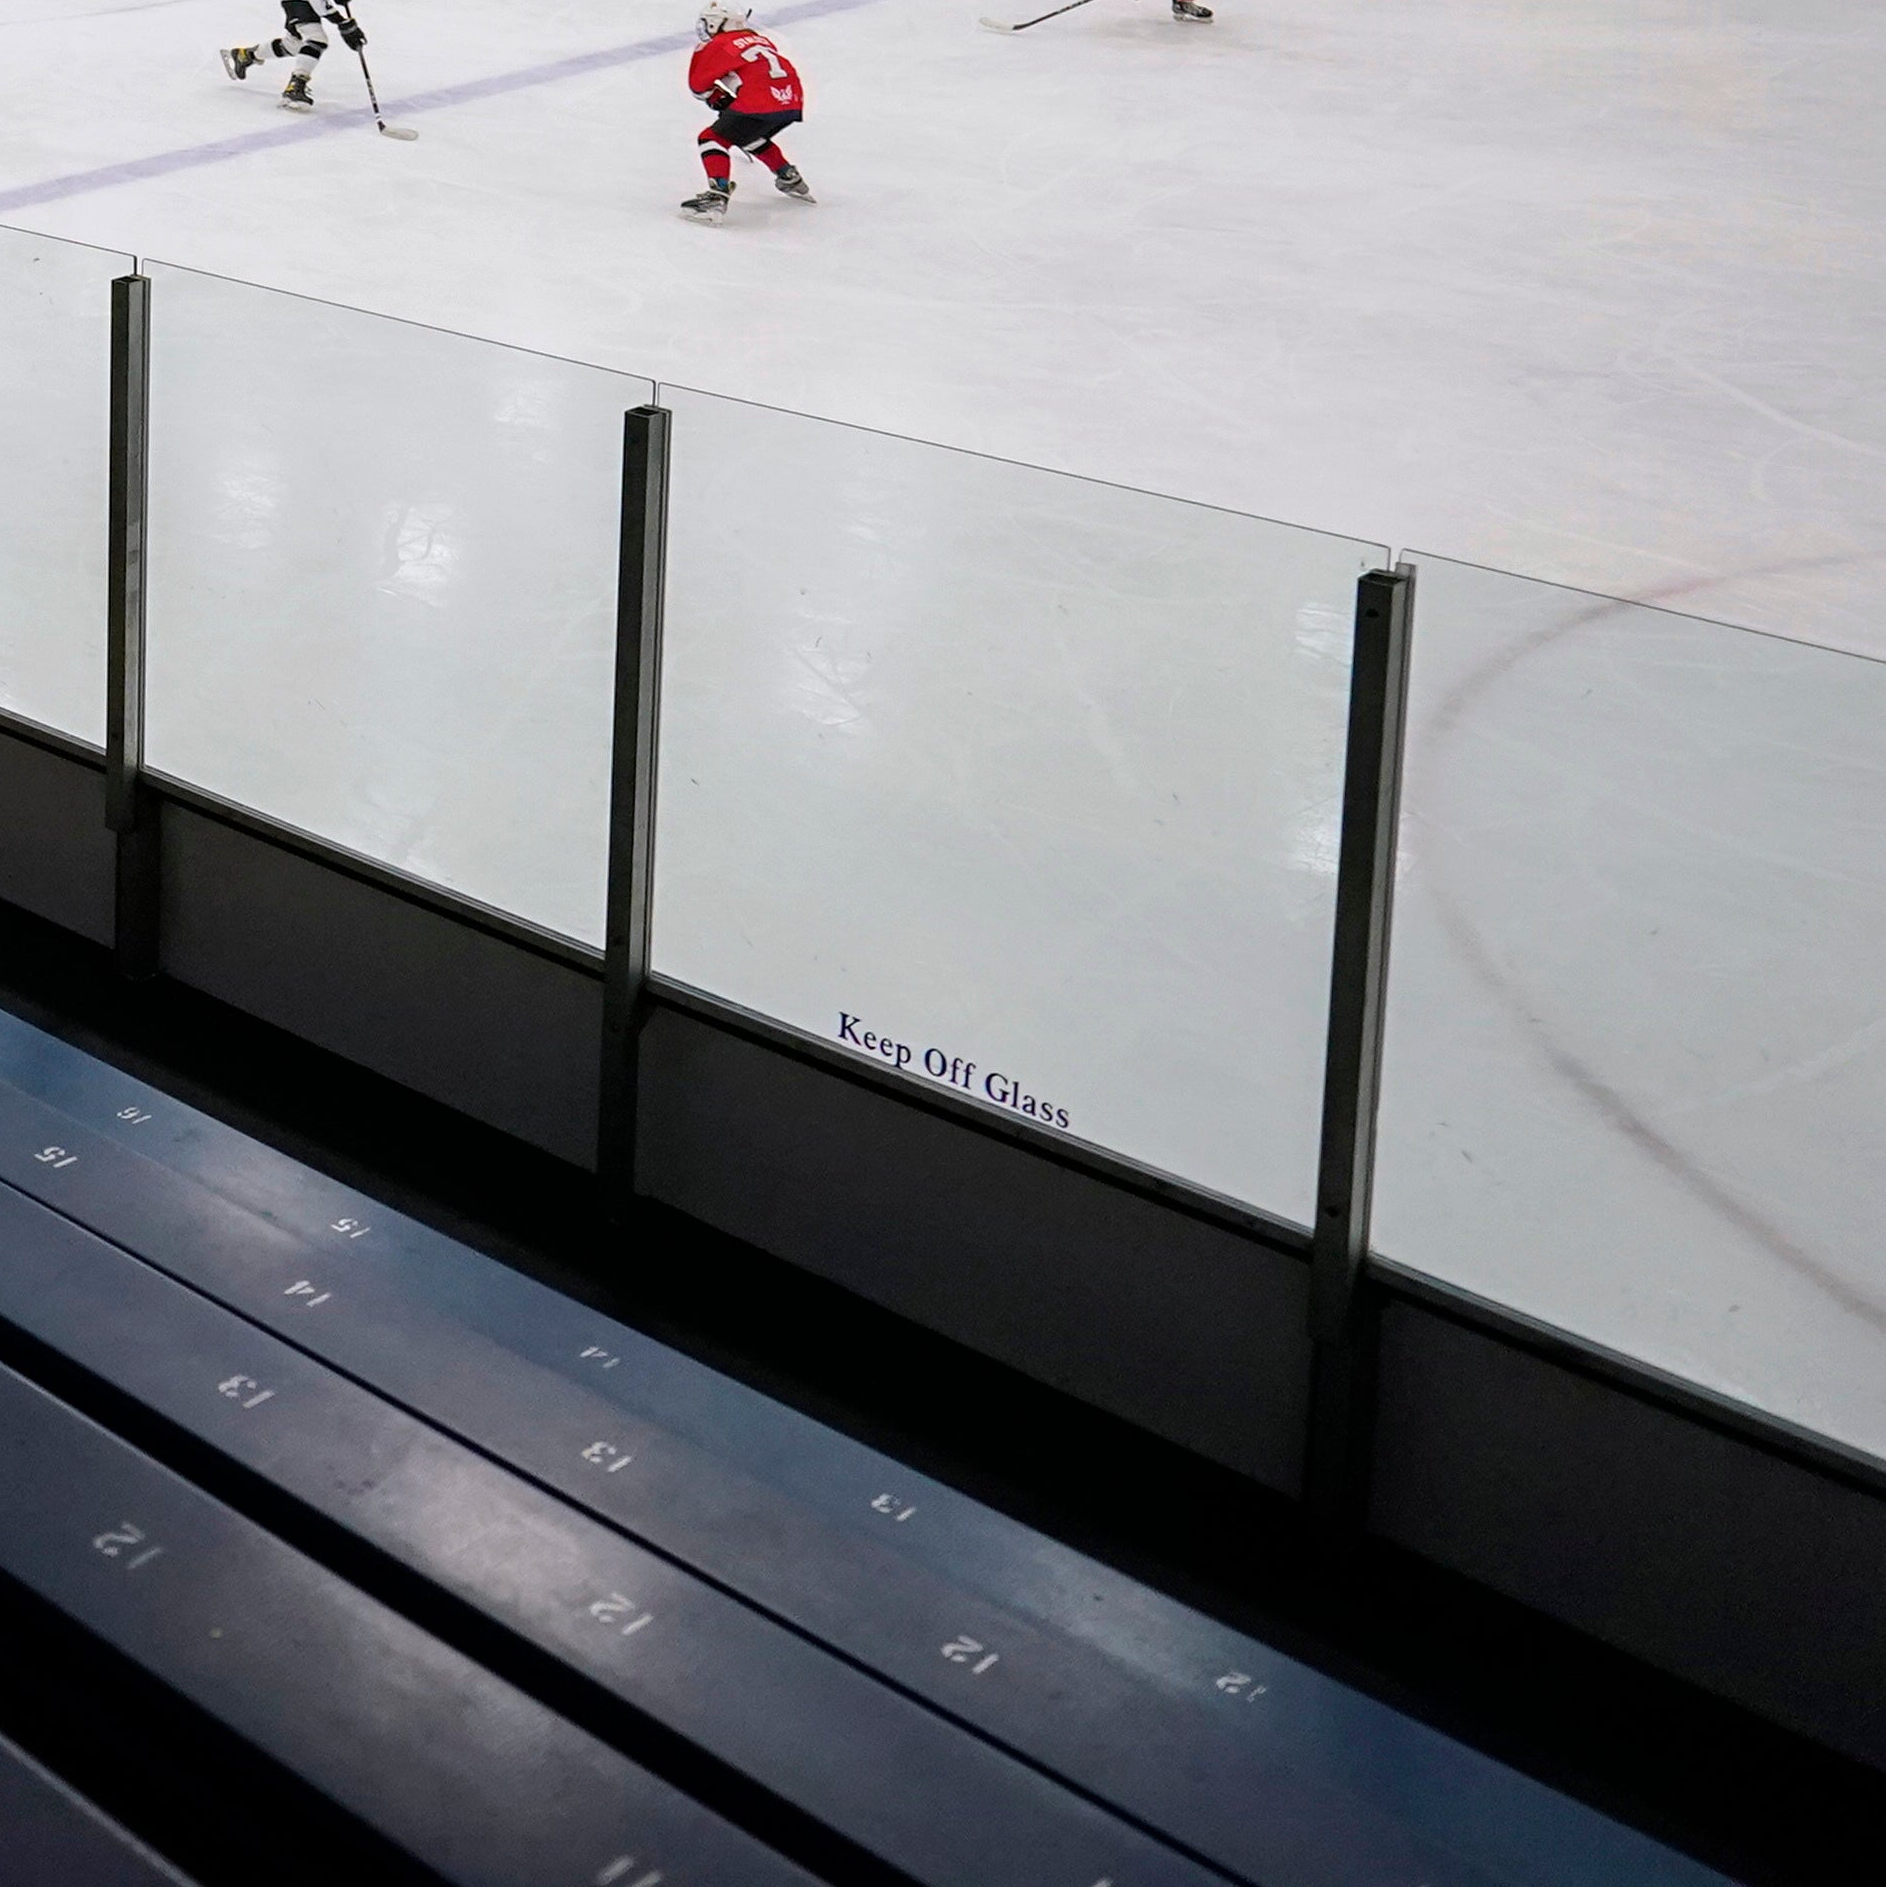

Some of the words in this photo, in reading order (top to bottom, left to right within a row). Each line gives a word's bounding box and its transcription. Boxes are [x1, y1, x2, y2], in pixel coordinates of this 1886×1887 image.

[740, 44, 788, 79] 7
[838, 1012, 911, 1068] Keep
[924, 1048, 976, 1089] Off
[985, 1073, 1070, 1128] Glass
[116, 1106, 152, 1124] 16
[34, 1146, 78, 1168] 15
[331, 1218, 370, 1239] 15
[283, 1280, 331, 1307] 14
[93, 1522, 161, 1569] 12
[589, 1591, 653, 1636] 12
[941, 1635, 999, 1674] 12
